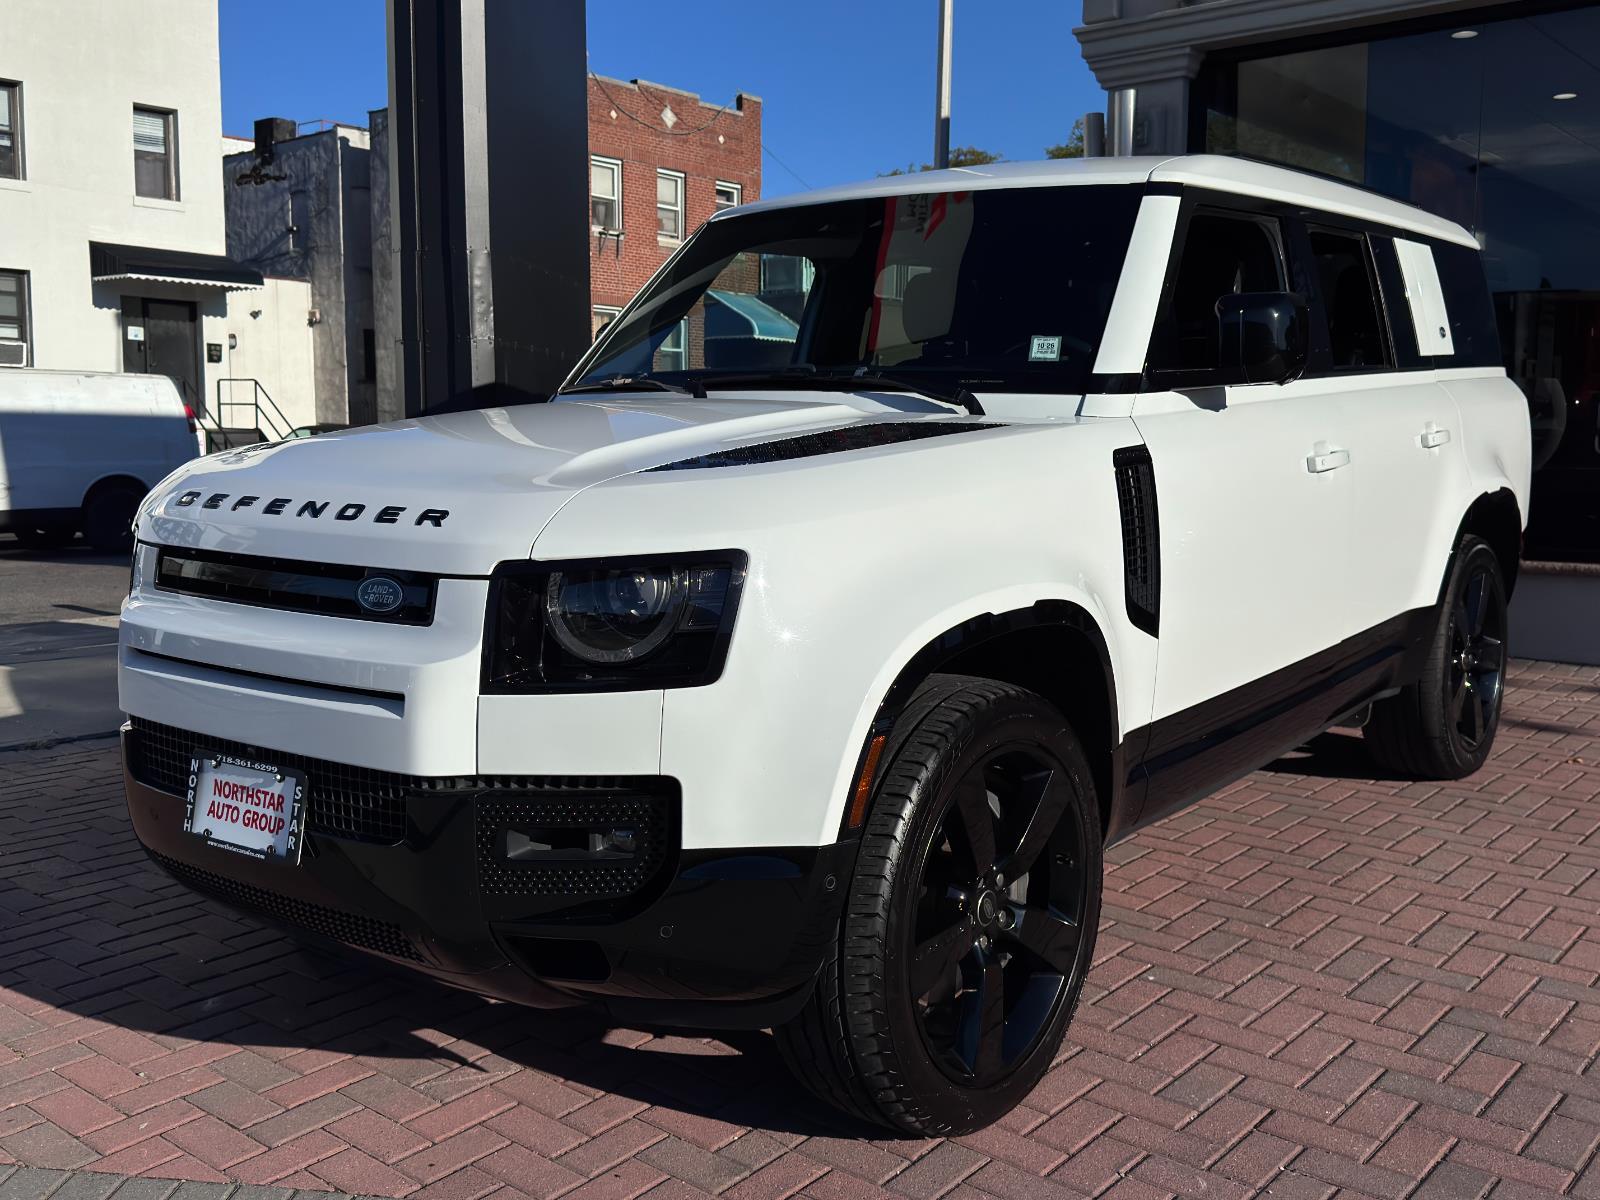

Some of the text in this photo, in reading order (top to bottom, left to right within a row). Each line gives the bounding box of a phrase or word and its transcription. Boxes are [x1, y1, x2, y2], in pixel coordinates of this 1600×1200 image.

[175, 491, 450, 528] DEFENDER
[367, 584, 389, 594] LAND
[368, 594, 394, 604] ROVER
[216, 754, 278, 774] 718-361-6299
[183, 758, 199, 832] NORTH
[213, 778, 285, 813] NORTHSTAR
[207, 800, 285, 835] AUTO GROUP
[287, 786, 302, 850] STAR
